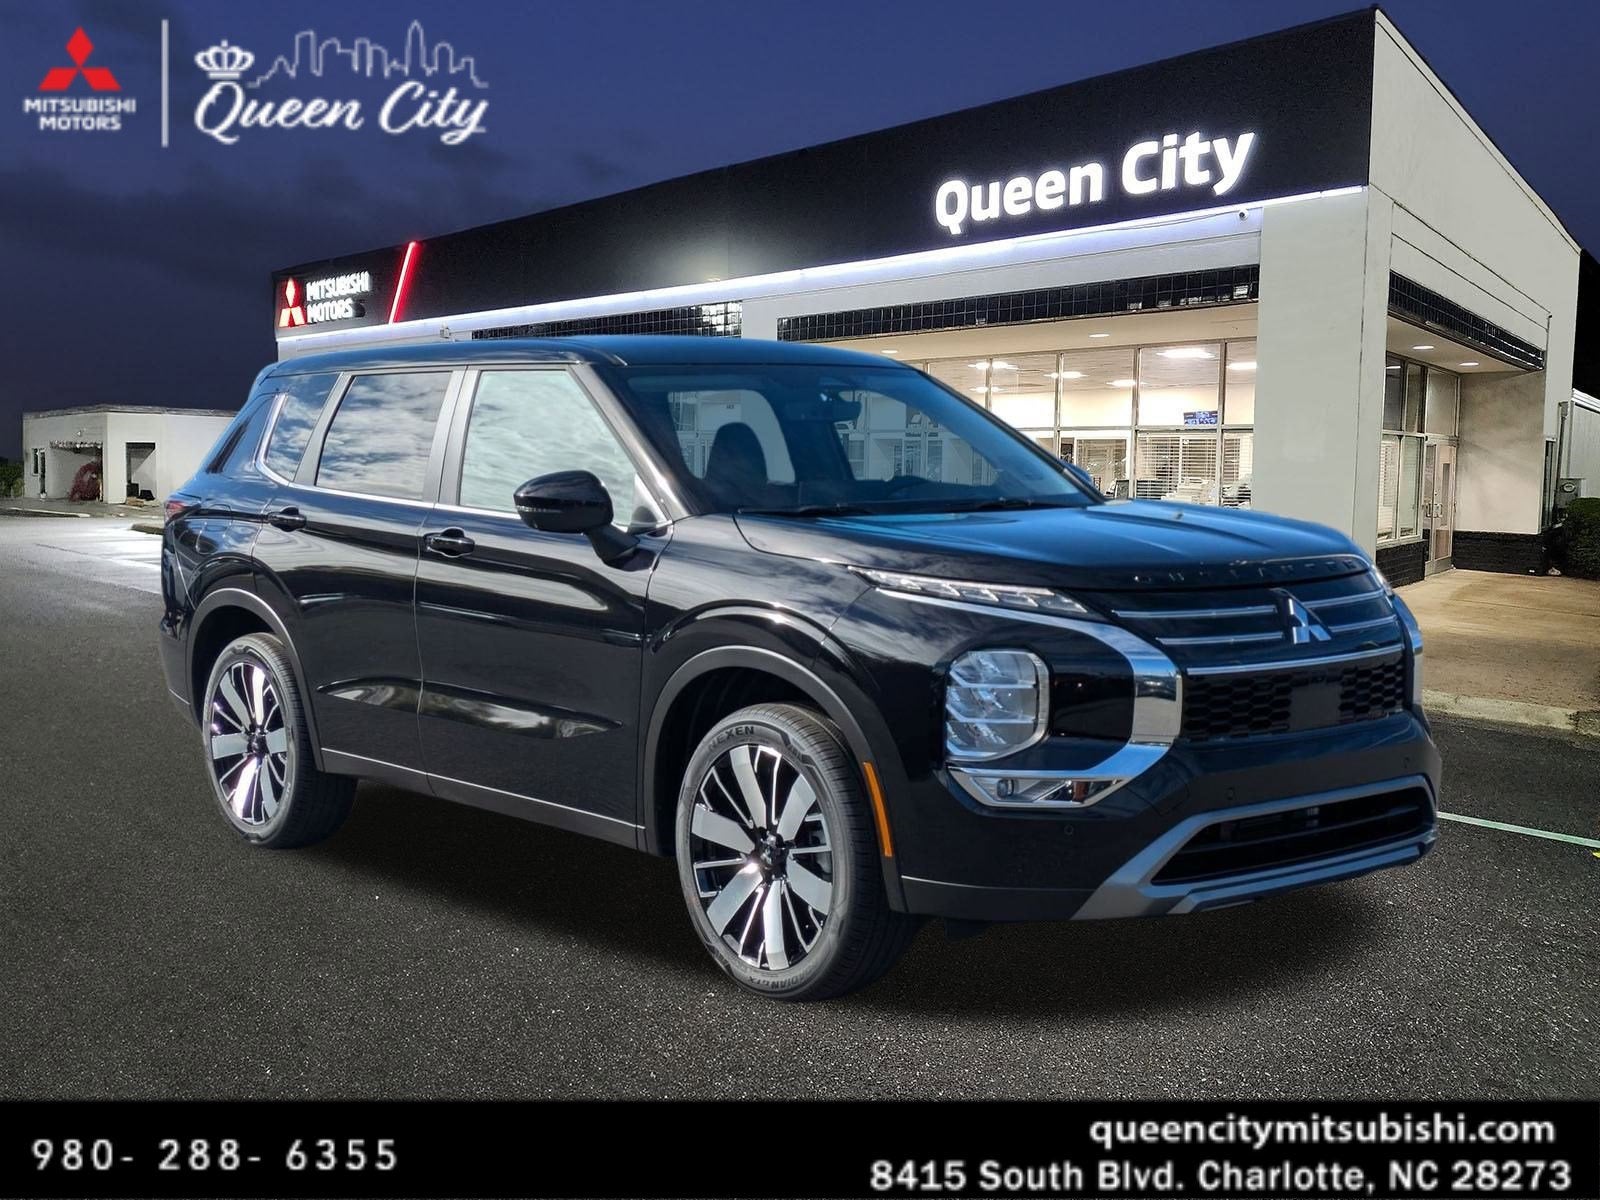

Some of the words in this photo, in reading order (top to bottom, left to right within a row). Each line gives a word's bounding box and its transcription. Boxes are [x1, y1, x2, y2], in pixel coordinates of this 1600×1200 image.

[935, 162, 1103, 235] Queen
[1121, 131, 1255, 196] City
[306, 271, 370, 302] MITSUBISHI
[306, 298, 354, 324] MOTORS
